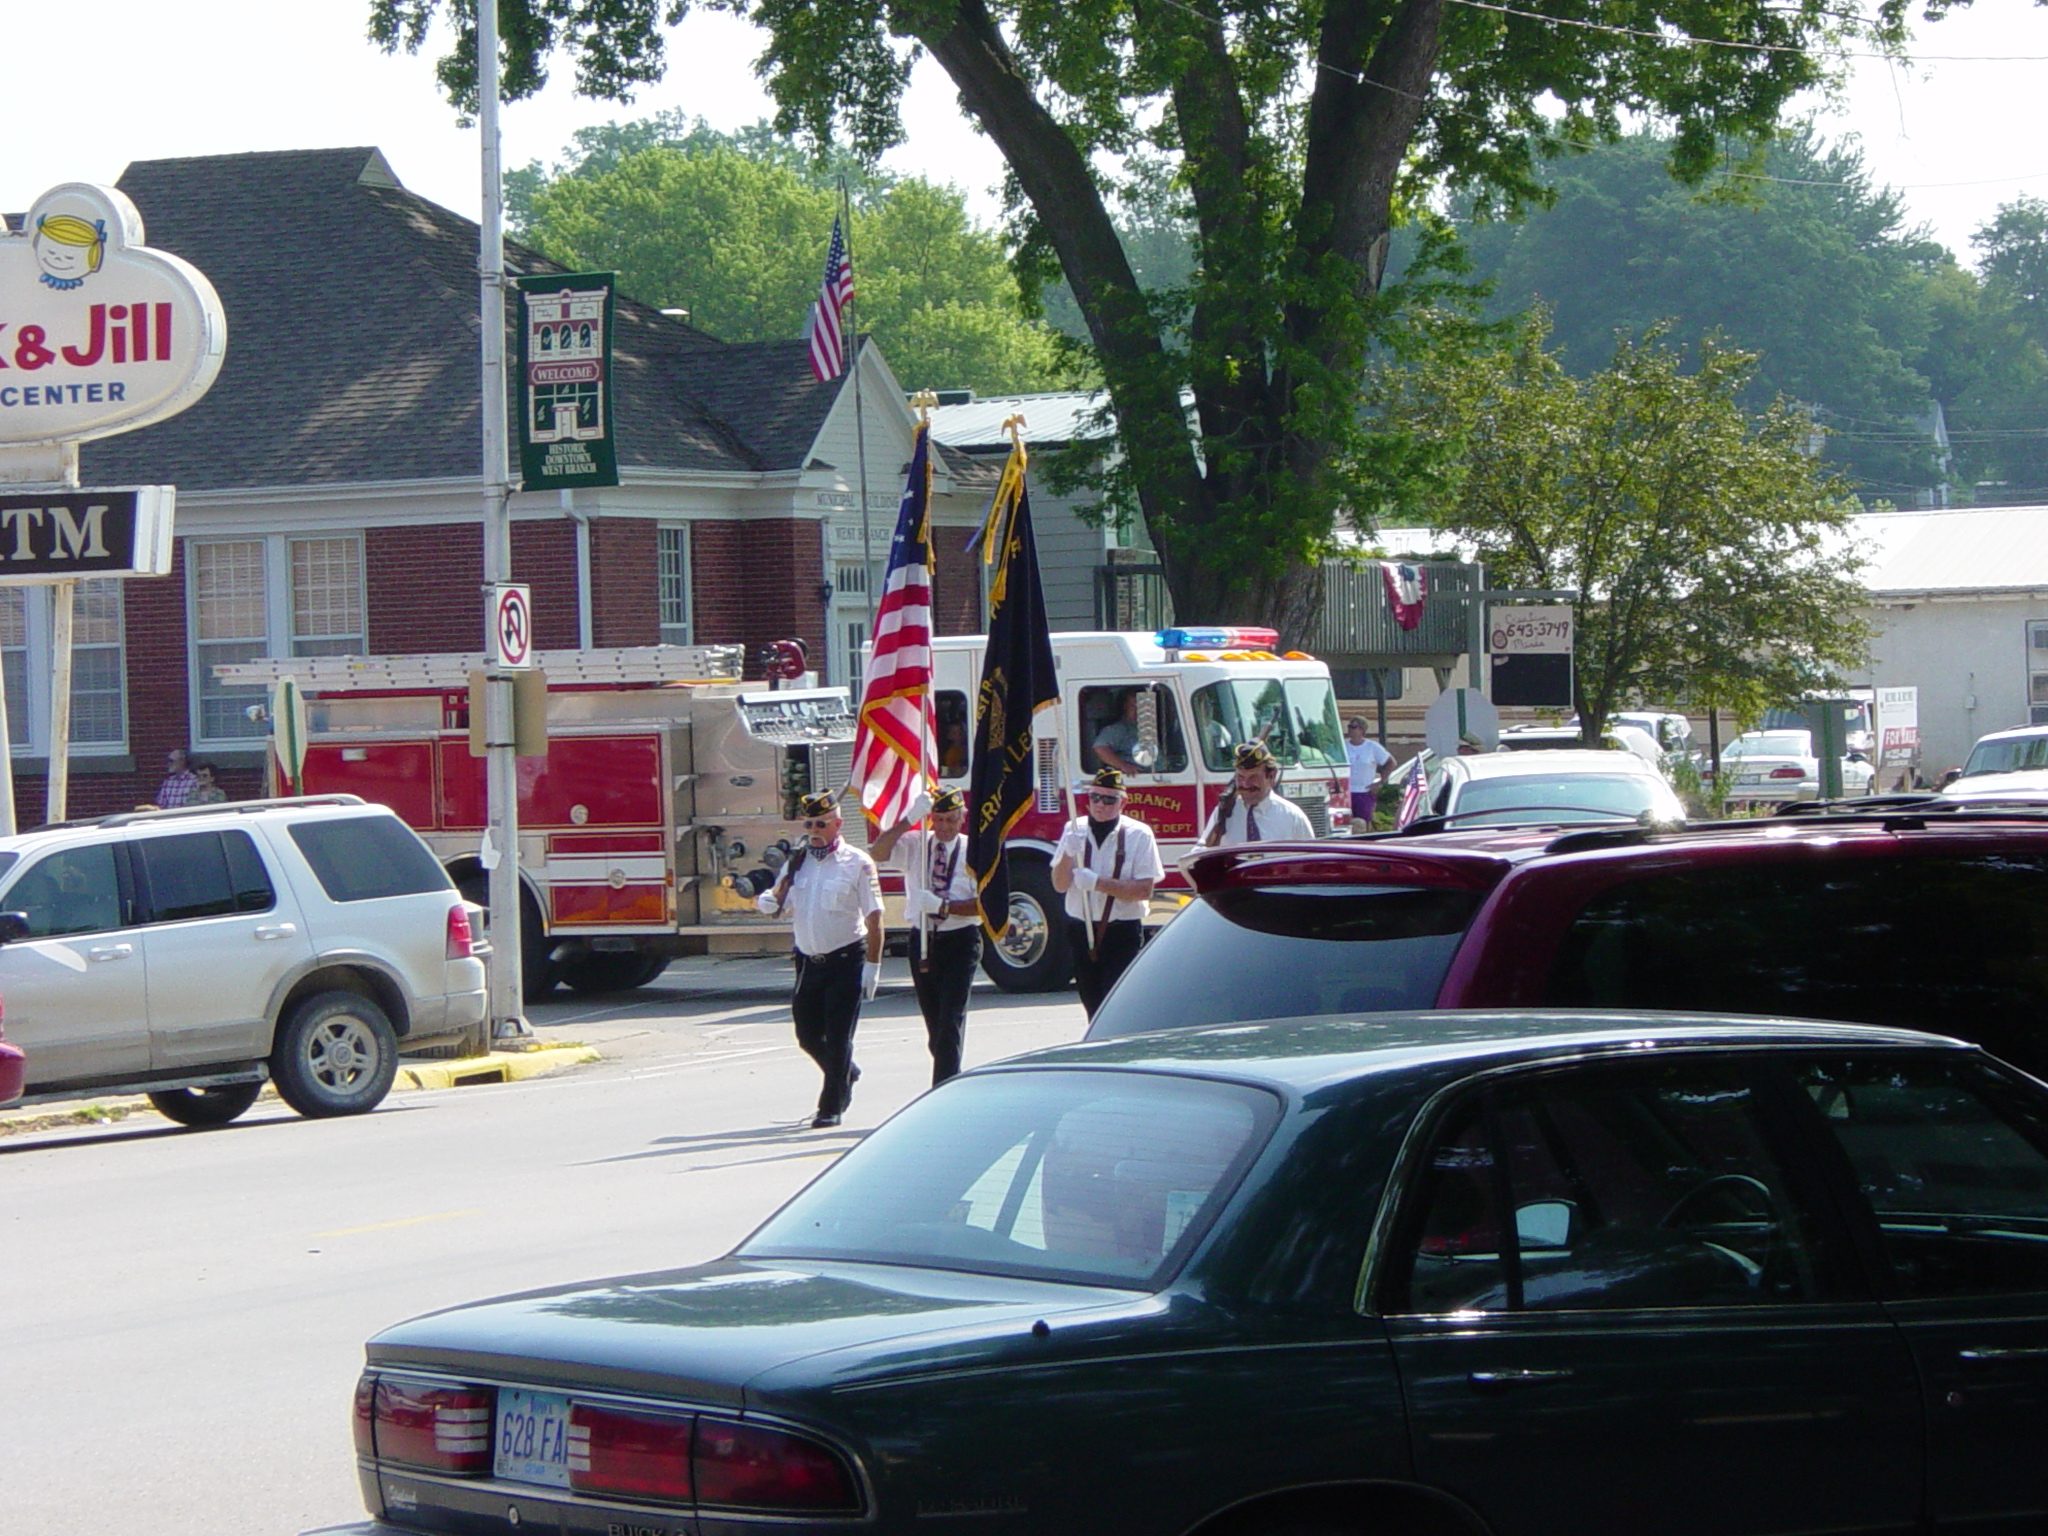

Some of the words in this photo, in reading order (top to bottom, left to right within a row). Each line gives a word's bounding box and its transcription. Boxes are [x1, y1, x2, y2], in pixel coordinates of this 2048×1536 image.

[537, 366, 594, 381] WELCOME
[0, 382, 126, 407] CENTER
[541, 465, 564, 476] WEST
[564, 462, 597, 475] BRANCH
[866, 495, 900, 508] UILDING
[0, 504, 111, 562] TM
[834, 527, 856, 541] WEST
[857, 527, 889, 541] BANCH
[1506, 621, 1569, 639] 643-3749
[1126, 792, 1182, 813] BRANCH
[502, 1411, 535, 1459] 628
